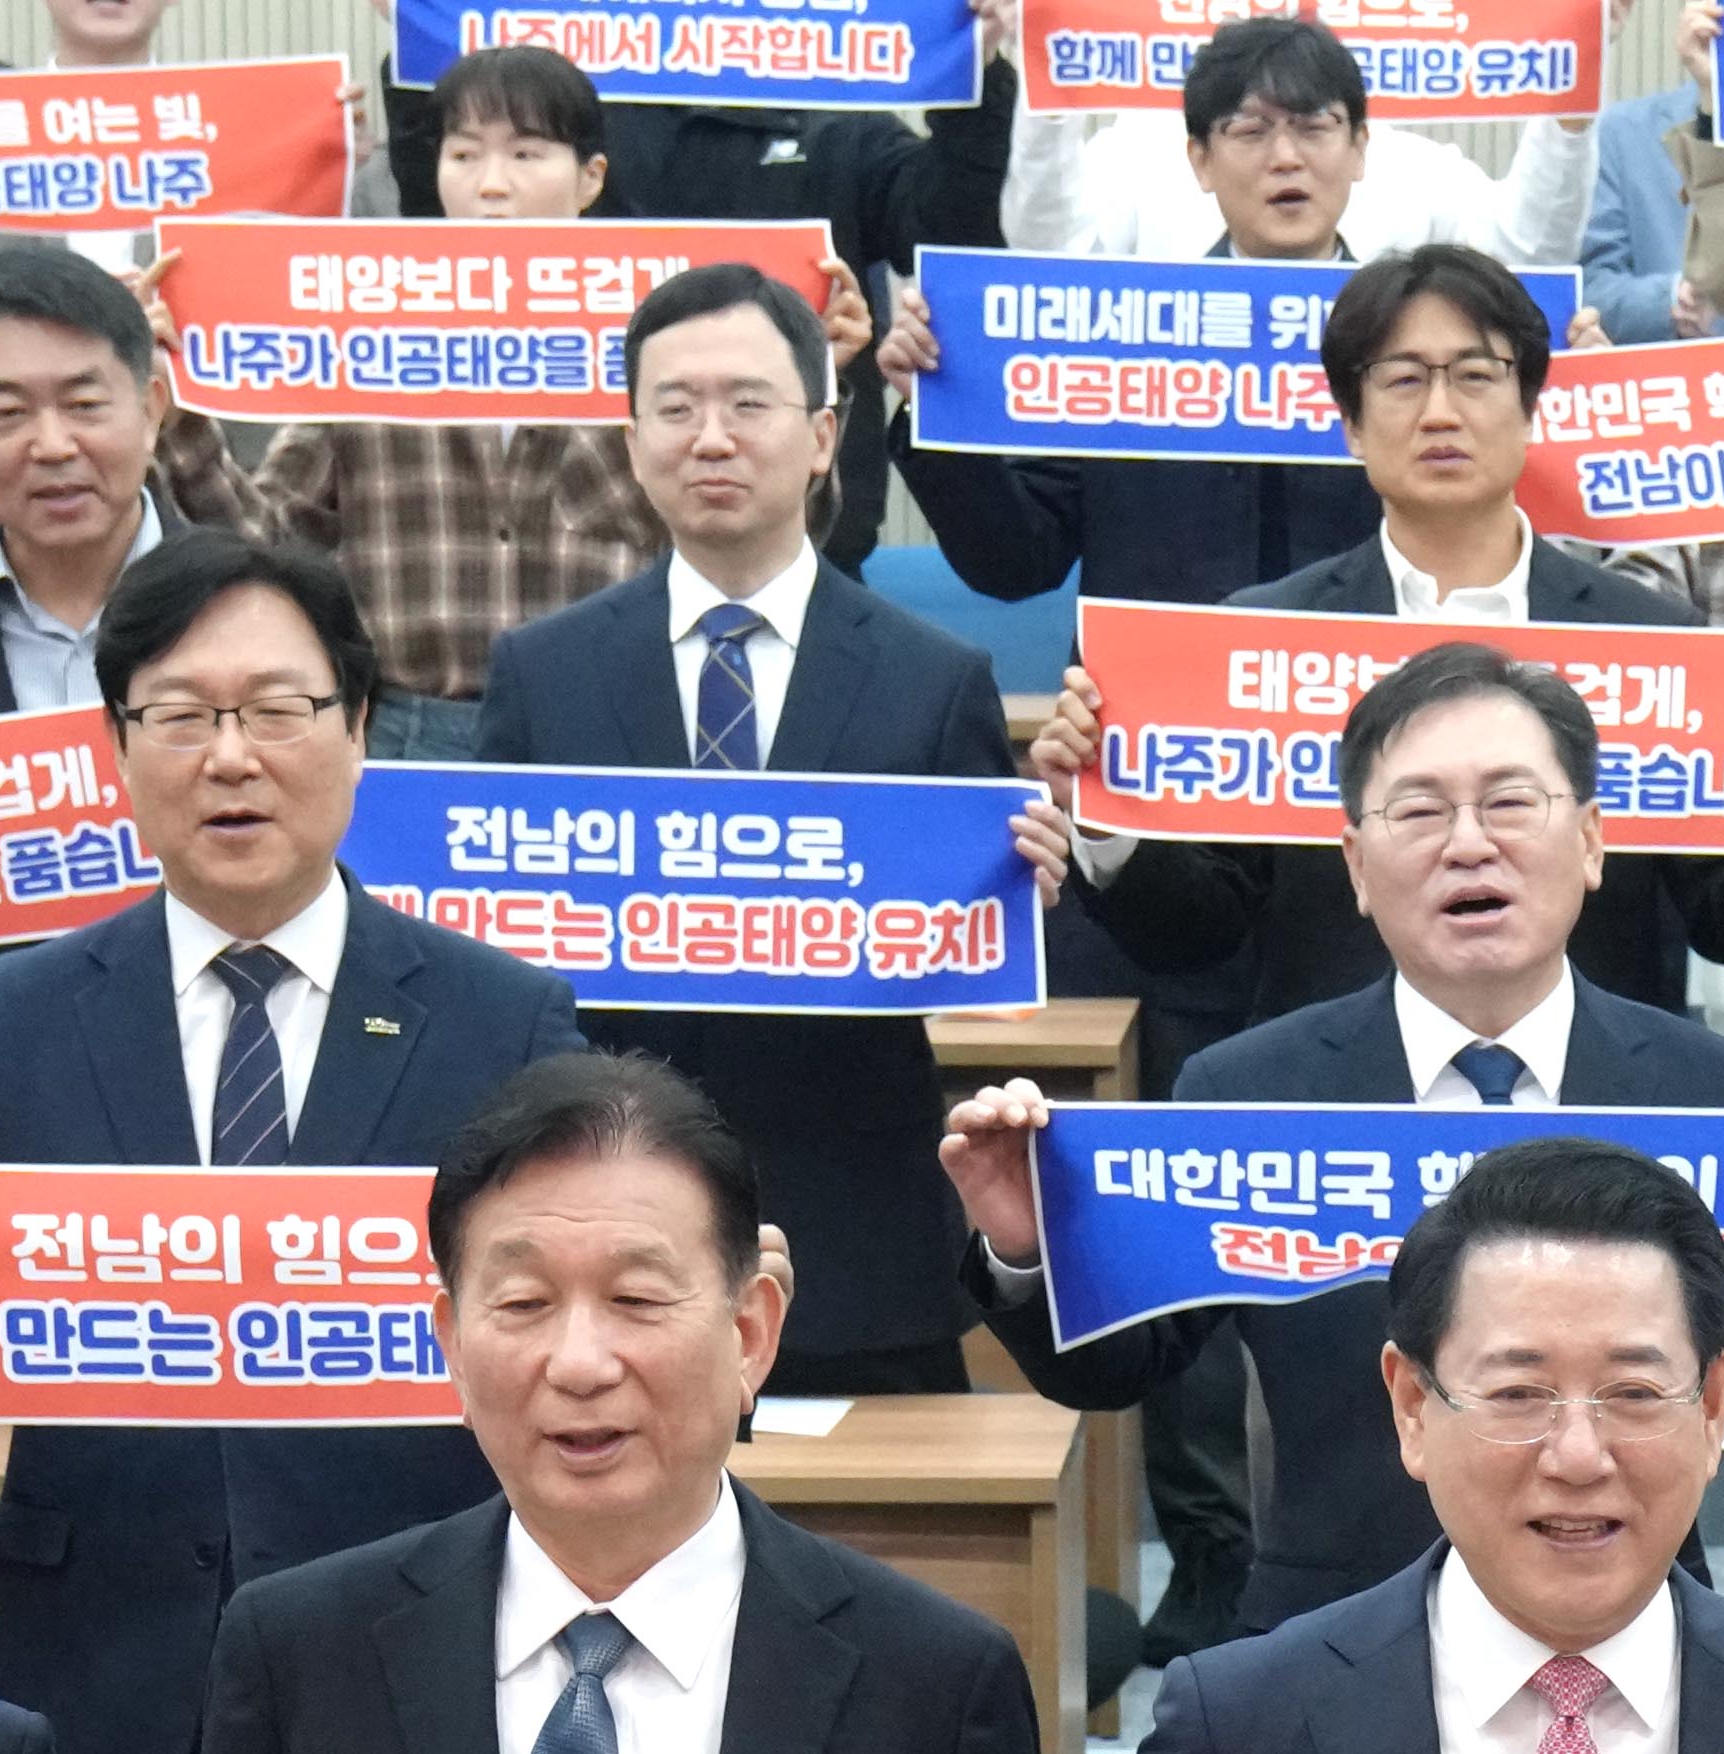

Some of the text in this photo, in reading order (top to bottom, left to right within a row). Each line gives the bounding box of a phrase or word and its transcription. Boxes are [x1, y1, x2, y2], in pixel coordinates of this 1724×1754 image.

[672, 20, 909, 78] 시작합니다
[1050, 35, 1137, 84] 함께
[1475, 43, 1576, 92] 유치!
[43, 98, 141, 145] 여는
[155, 94, 217, 142] 빛,
[116, 158, 208, 205] 나주
[290, 255, 512, 312] 태양보다
[984, 285, 1253, 350] 미래세대를
[188, 331, 332, 385] 나주가
[348, 332, 588, 389] 인공태양을
[1007, 361, 1225, 420] 인공태양
[1109, 734, 1272, 802] 나주가
[447, 806, 864, 886] 전남의 힘으로,
[628, 900, 858, 968] 인공태양
[873, 902, 998, 969] 유치!
[1093, 1147, 1395, 1220] 대한민국
[10, 1212, 442, 1289] 전남의 힘으
[6, 1307, 214, 1377] 만드는
[236, 1310, 447, 1379] 인공태
